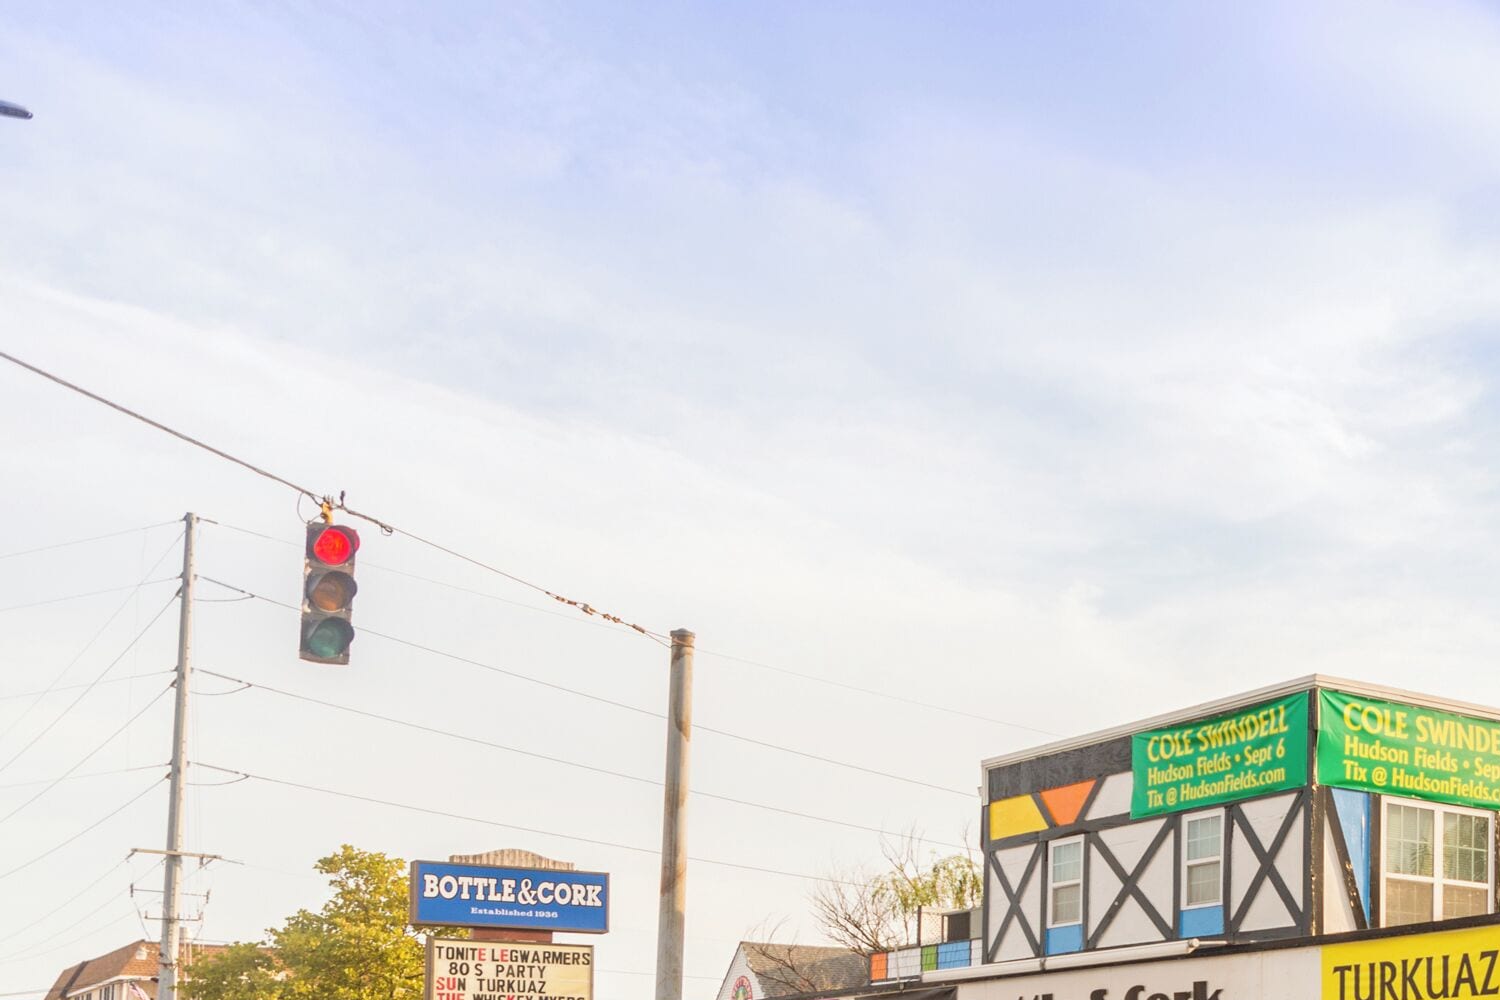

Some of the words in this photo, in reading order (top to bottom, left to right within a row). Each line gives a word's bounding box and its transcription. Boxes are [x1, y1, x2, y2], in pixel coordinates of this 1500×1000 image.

[1147, 729, 1195, 763] COLE
[1196, 705, 1288, 752] SWINDELL
[1343, 702, 1409, 739] COLE
[1147, 763, 1193, 787] Hudson
[1197, 752, 1232, 777] Fields
[1244, 744, 1272, 767] Sept
[1276, 738, 1285, 759] 6
[1344, 735, 1409, 765] Hudson
[1414, 746, 1458, 773] Fields
[1147, 790, 1163, 808] Tix
[1166, 787, 1177, 806] @
[1180, 767, 1286, 802] HudsonFields.com
[1343, 759, 1368, 782] Tix
[1372, 766, 1387, 786] @
[471, 907, 533, 918] Established
[436, 946, 487, 962] TONITE
[491, 948, 591, 966] LEGWARMERS
[449, 962, 470, 976] 80
[474, 963, 483, 976] S
[495, 964, 546, 979] PARTY
[436, 977, 466, 992] SUN
[477, 978, 546, 994] TURKUAZ
